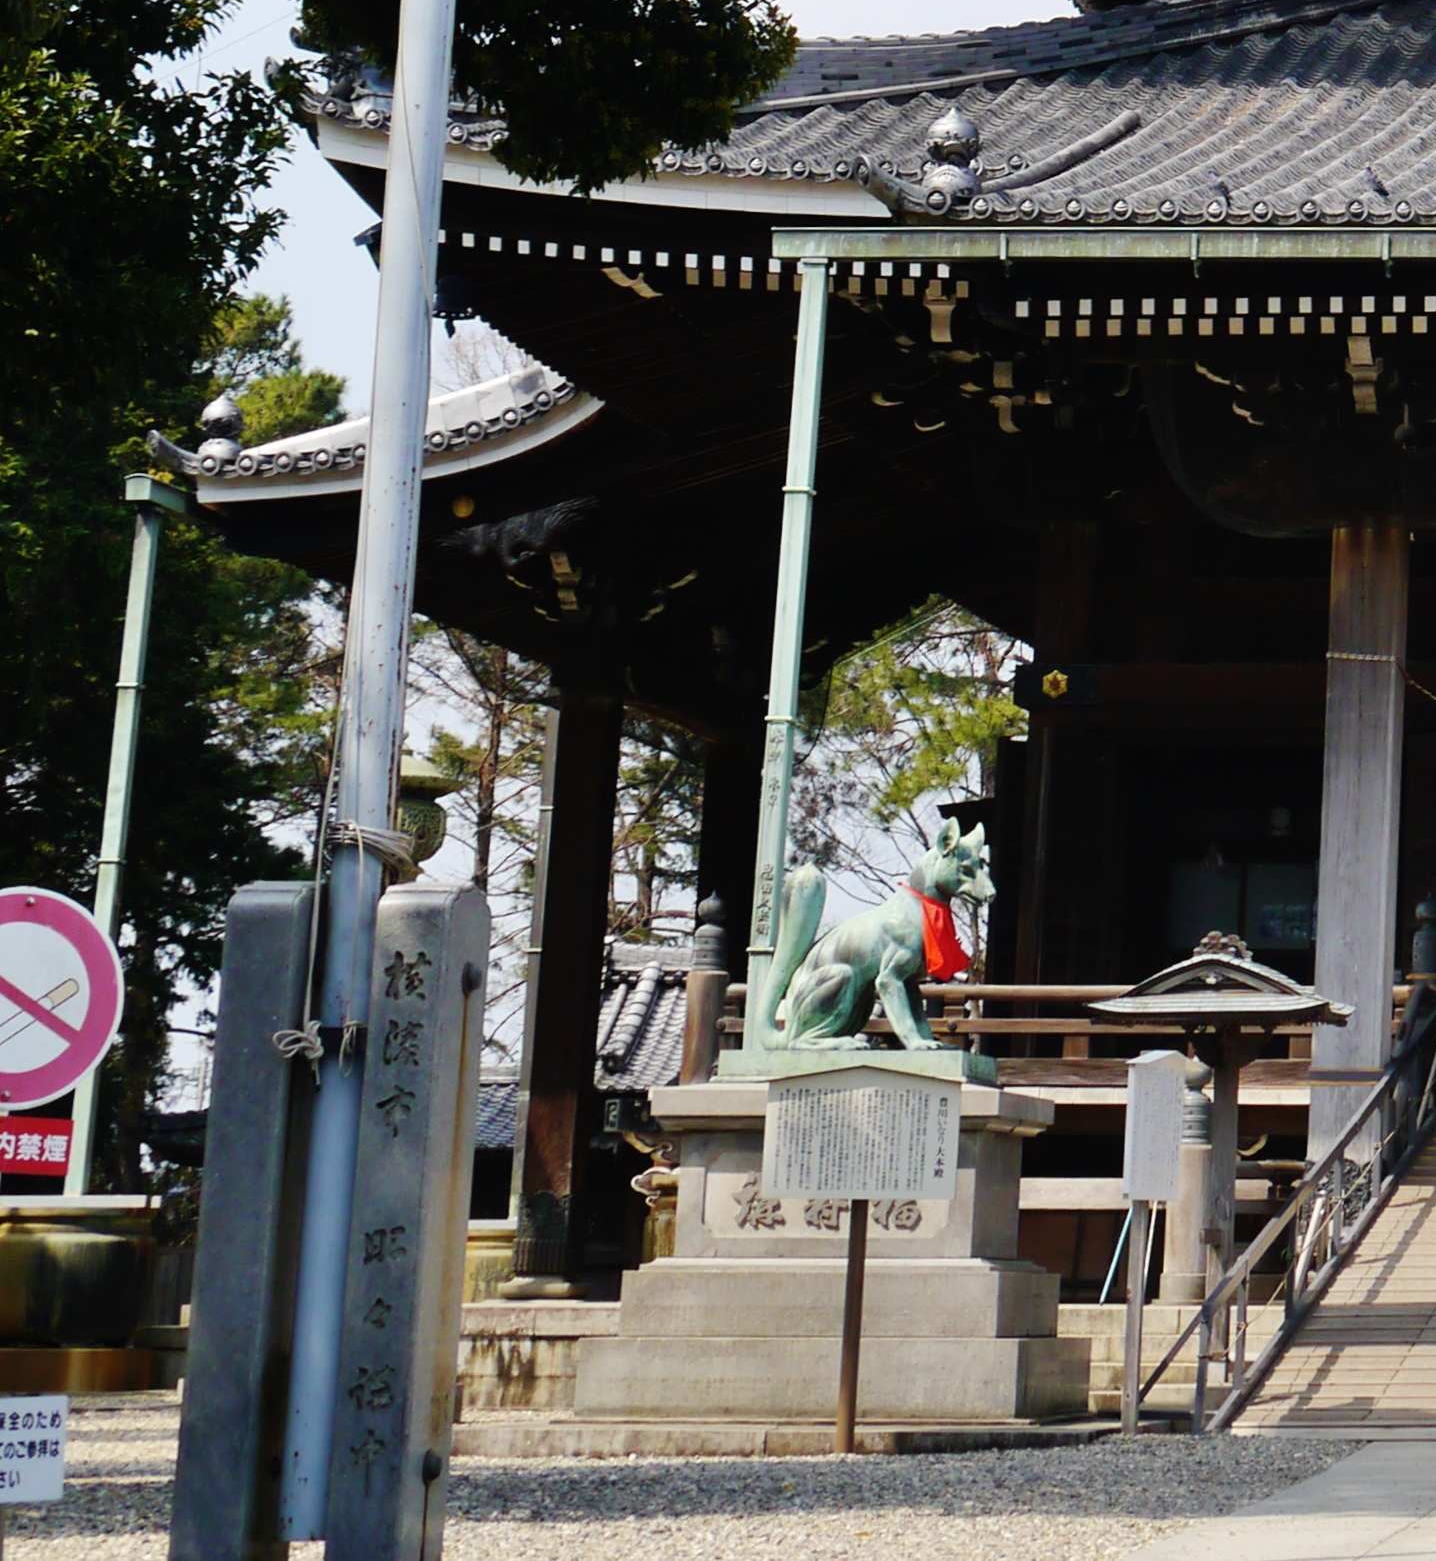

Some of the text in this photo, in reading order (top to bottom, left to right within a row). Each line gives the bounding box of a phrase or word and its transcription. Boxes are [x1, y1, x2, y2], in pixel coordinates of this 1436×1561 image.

[0, 1439, 60, 1459] のご参拝は
